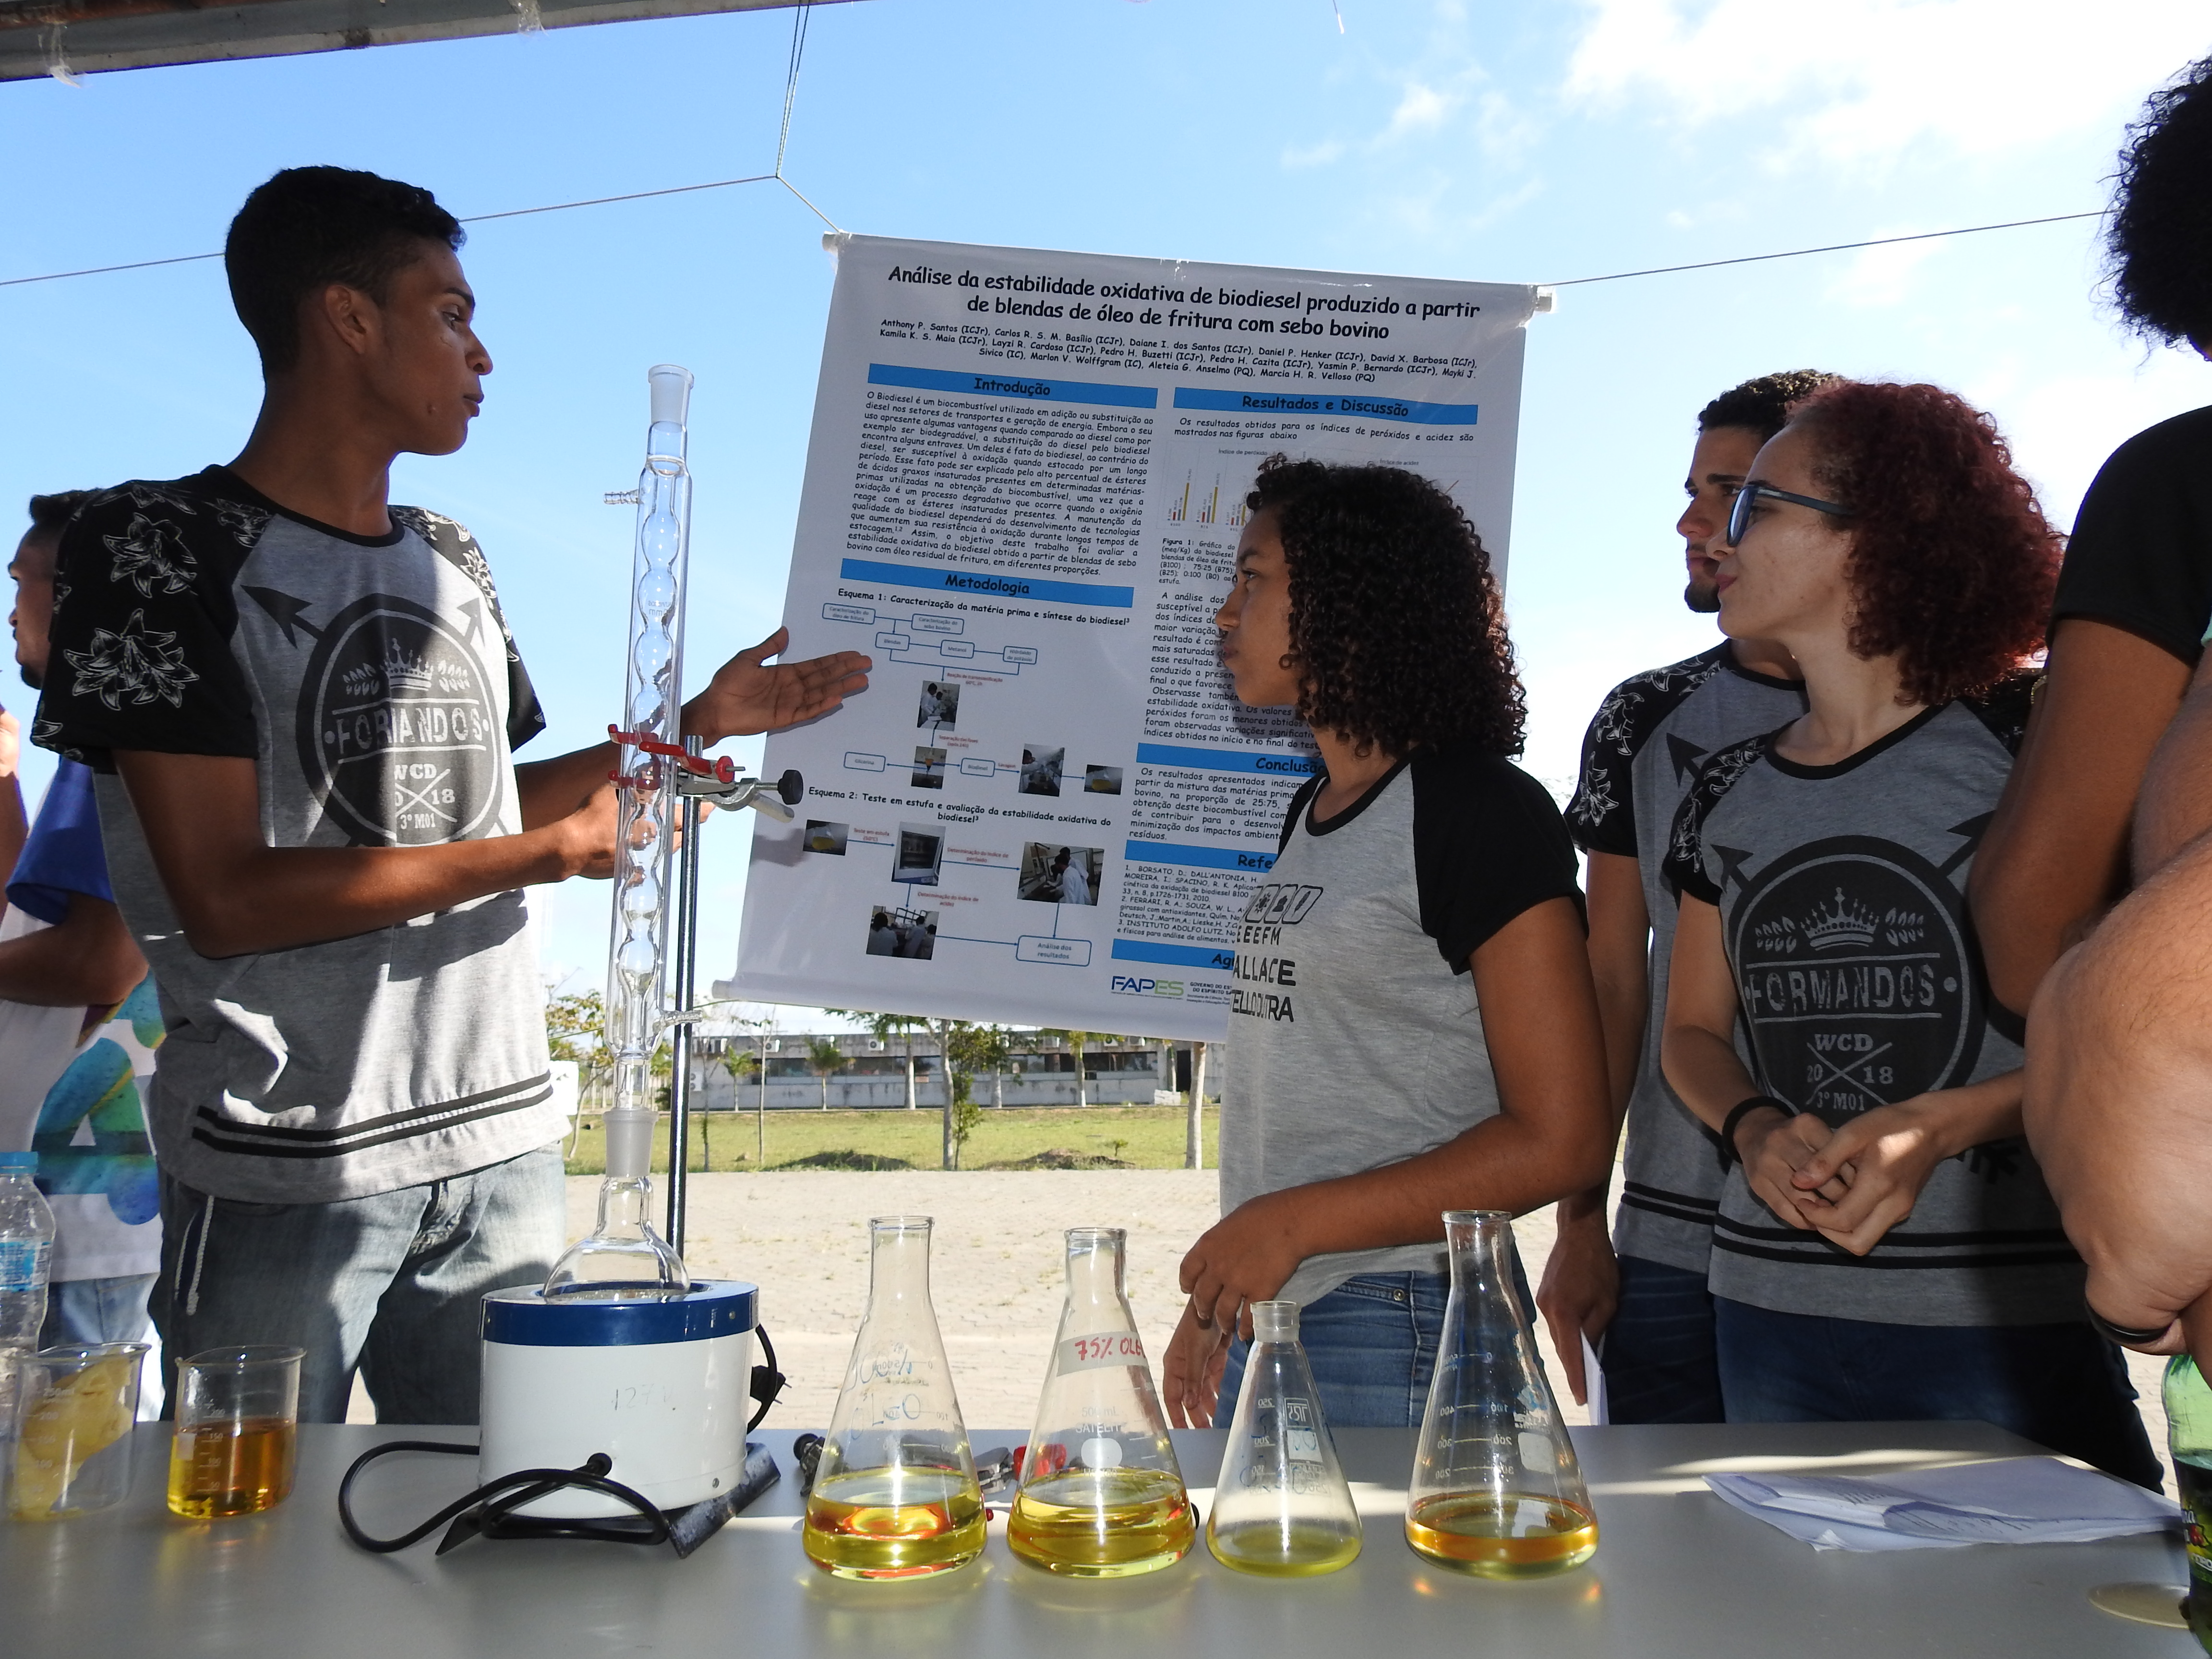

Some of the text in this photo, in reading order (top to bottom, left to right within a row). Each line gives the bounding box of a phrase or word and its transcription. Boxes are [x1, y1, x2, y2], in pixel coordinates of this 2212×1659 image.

[888, 266, 1480, 321] Análise da estabilidade oxidativa de biodiesel produzido a partir
[967, 295, 1389, 339] de blendas de óleo de fritura com sebo bovino
[979, 348, 1375, 383] Sivico (IC), Marlon V. Wolffgram (IC), Aleteia G. Anselmo (PQ), Marcia H. R. Velloso (PQ)
[974, 377, 1051, 397] Introdução
[877, 392, 914, 403] Biodiesel
[915, 396, 921, 404] é
[938, 398, 998, 411] biocombustível
[999, 405, 1034, 415] utilizado
[1051, 409, 1077, 420] adição
[1092, 413, 1142, 425] substituição
[1242, 395, 1409, 417] Resultados e Discussão
[1179, 417, 1191, 426] Os
[1196, 419, 1240, 428] resultados
[1245, 421, 1276, 429] obtidos
[1321, 422, 1350, 433] índices
[1355, 426, 1366, 435] de
[1370, 429, 1410, 440] peróxidos
[1426, 433, 1454, 441] acidez
[846, 541, 873, 552] bovino
[893, 546, 910, 556] óleo
[912, 550, 946, 560] residual
[947, 553, 957, 561] de
[960, 553, 991, 566] fritura,
[1007, 559, 1051, 571] diferentes
[1053, 565, 1101, 576] proporções.
[945, 574, 1030, 596] Metodologia
[838, 588, 874, 600] Esquema
[890, 595, 954, 610] Caracterização
[957, 602, 968, 610] da
[971, 605, 1004, 614] matéria
[1007, 608, 1031, 617] prima
[1043, 611, 1072, 621] síntese
[1076, 614, 1086, 623] do
[1147, 697, 1198, 708] estabilidade
[1201, 701, 1240, 712] oxidativa.
[1262, 707, 1291, 716] valores
[337, 706, 483, 754] FORANDOS
[1141, 767, 1153, 776] Os
[1158, 770, 1203, 781] resultados
[1208, 775, 1265, 786] apresentados
[431, 788, 456, 805] 18
[808, 786, 845, 798] Esquema
[862, 793, 887, 803] Teste
[906, 800, 934, 808] estufa
[946, 804, 985, 814] avaliação
[988, 806, 999, 815] da
[1002, 810, 1054, 821] estabilidade
[1058, 815, 1097, 825] oxidativa
[1238, 854, 1273, 869] Refe
[1126, 920, 1170, 930] INSTITUTO
[1172, 925, 1202, 933] ADOLFO
[1111, 975, 1184, 996] FAPES
[1749, 963, 1935, 1014] FORMANDOS
[1815, 1034, 1874, 1051] WCD
[1807, 1063, 1893, 1084] 20 18
[1833, 1094, 1865, 1111] M01
[1075, 1336, 1114, 1361] 75%
